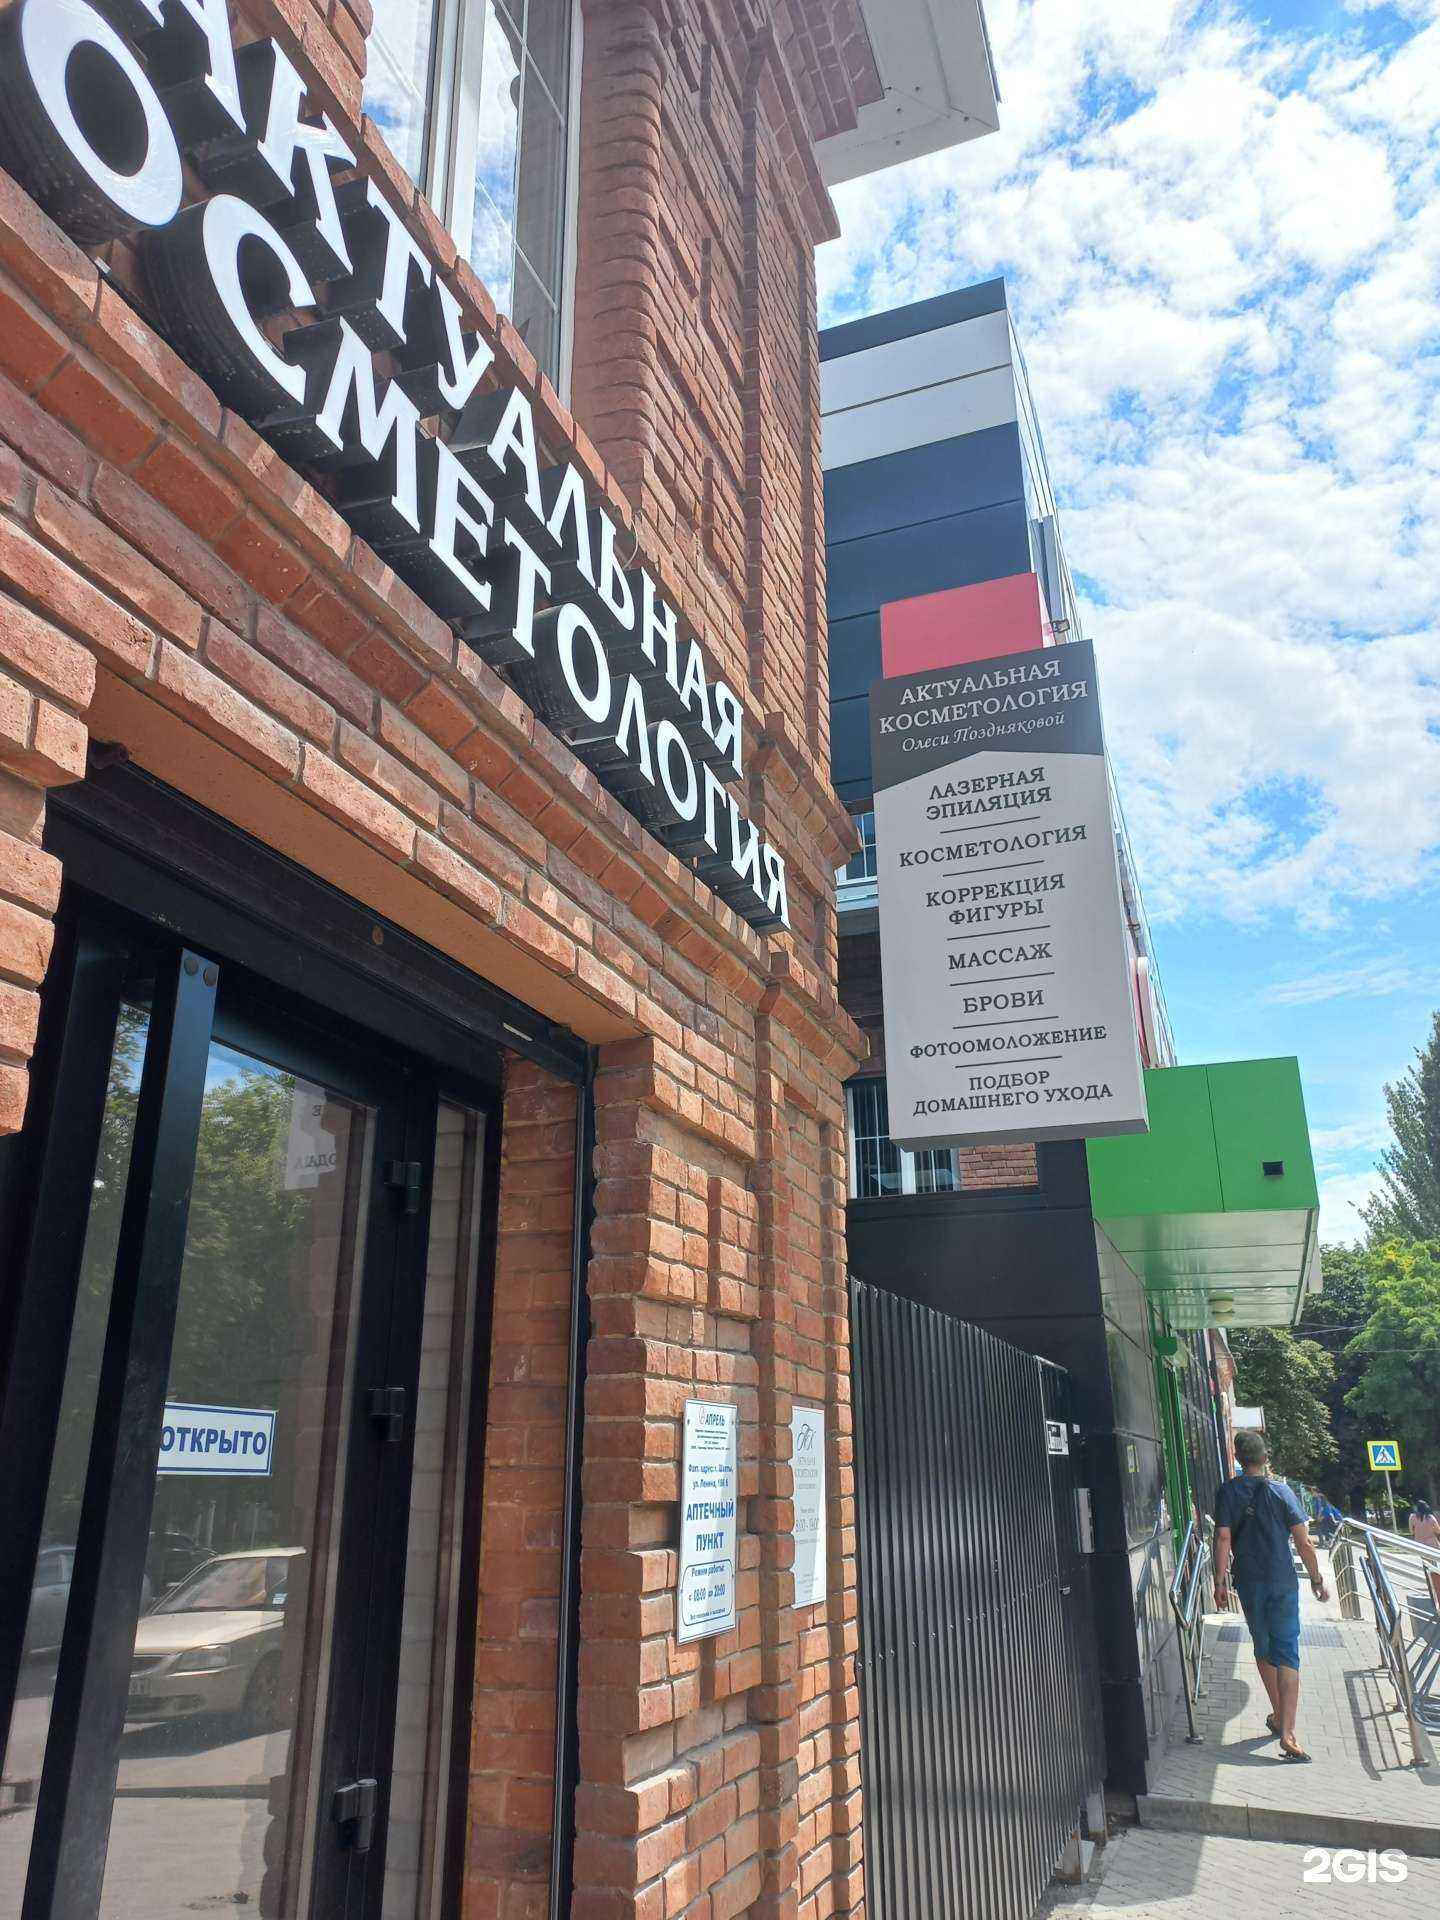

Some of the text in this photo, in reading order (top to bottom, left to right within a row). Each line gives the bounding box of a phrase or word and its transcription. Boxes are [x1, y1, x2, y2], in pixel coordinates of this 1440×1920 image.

[900, 659, 1062, 706] АКТУАЛЬНАЯ
[879, 680, 1089, 735] КОСМЕТОЛОГИЯ
[902, 711, 1065, 752] Олеси Поздняковой
[929, 767, 1046, 801] ЛАЗЕРНАЯ
[926, 786, 1052, 821] ЭПИЛЯЦИЯ
[899, 824, 1088, 868] КОСМЕТОЛОГИЯ
[926, 873, 1066, 908] КОРРЕКЦИЯ
[949, 899, 1044, 925] ФИГУРЫ
[948, 942, 1053, 970] МАССАЖ
[962, 989, 1045, 1014] БРОВИ
[910, 1026, 1108, 1059] ФОТООМОЛОЖЕНИЕ
[968, 1070, 1051, 1091] ПОДБОР
[912, 1084, 1114, 1117] ДОМАШНЕГО УХОДА
[705, 1413, 726, 1426] АПРЕЛЬ
[160, 1425, 267, 1455] ОТКРЫТО
[686, 1498, 734, 1521] АПТЕЧНЫЙ
[696, 1531, 725, 1551] ПУНКТ
